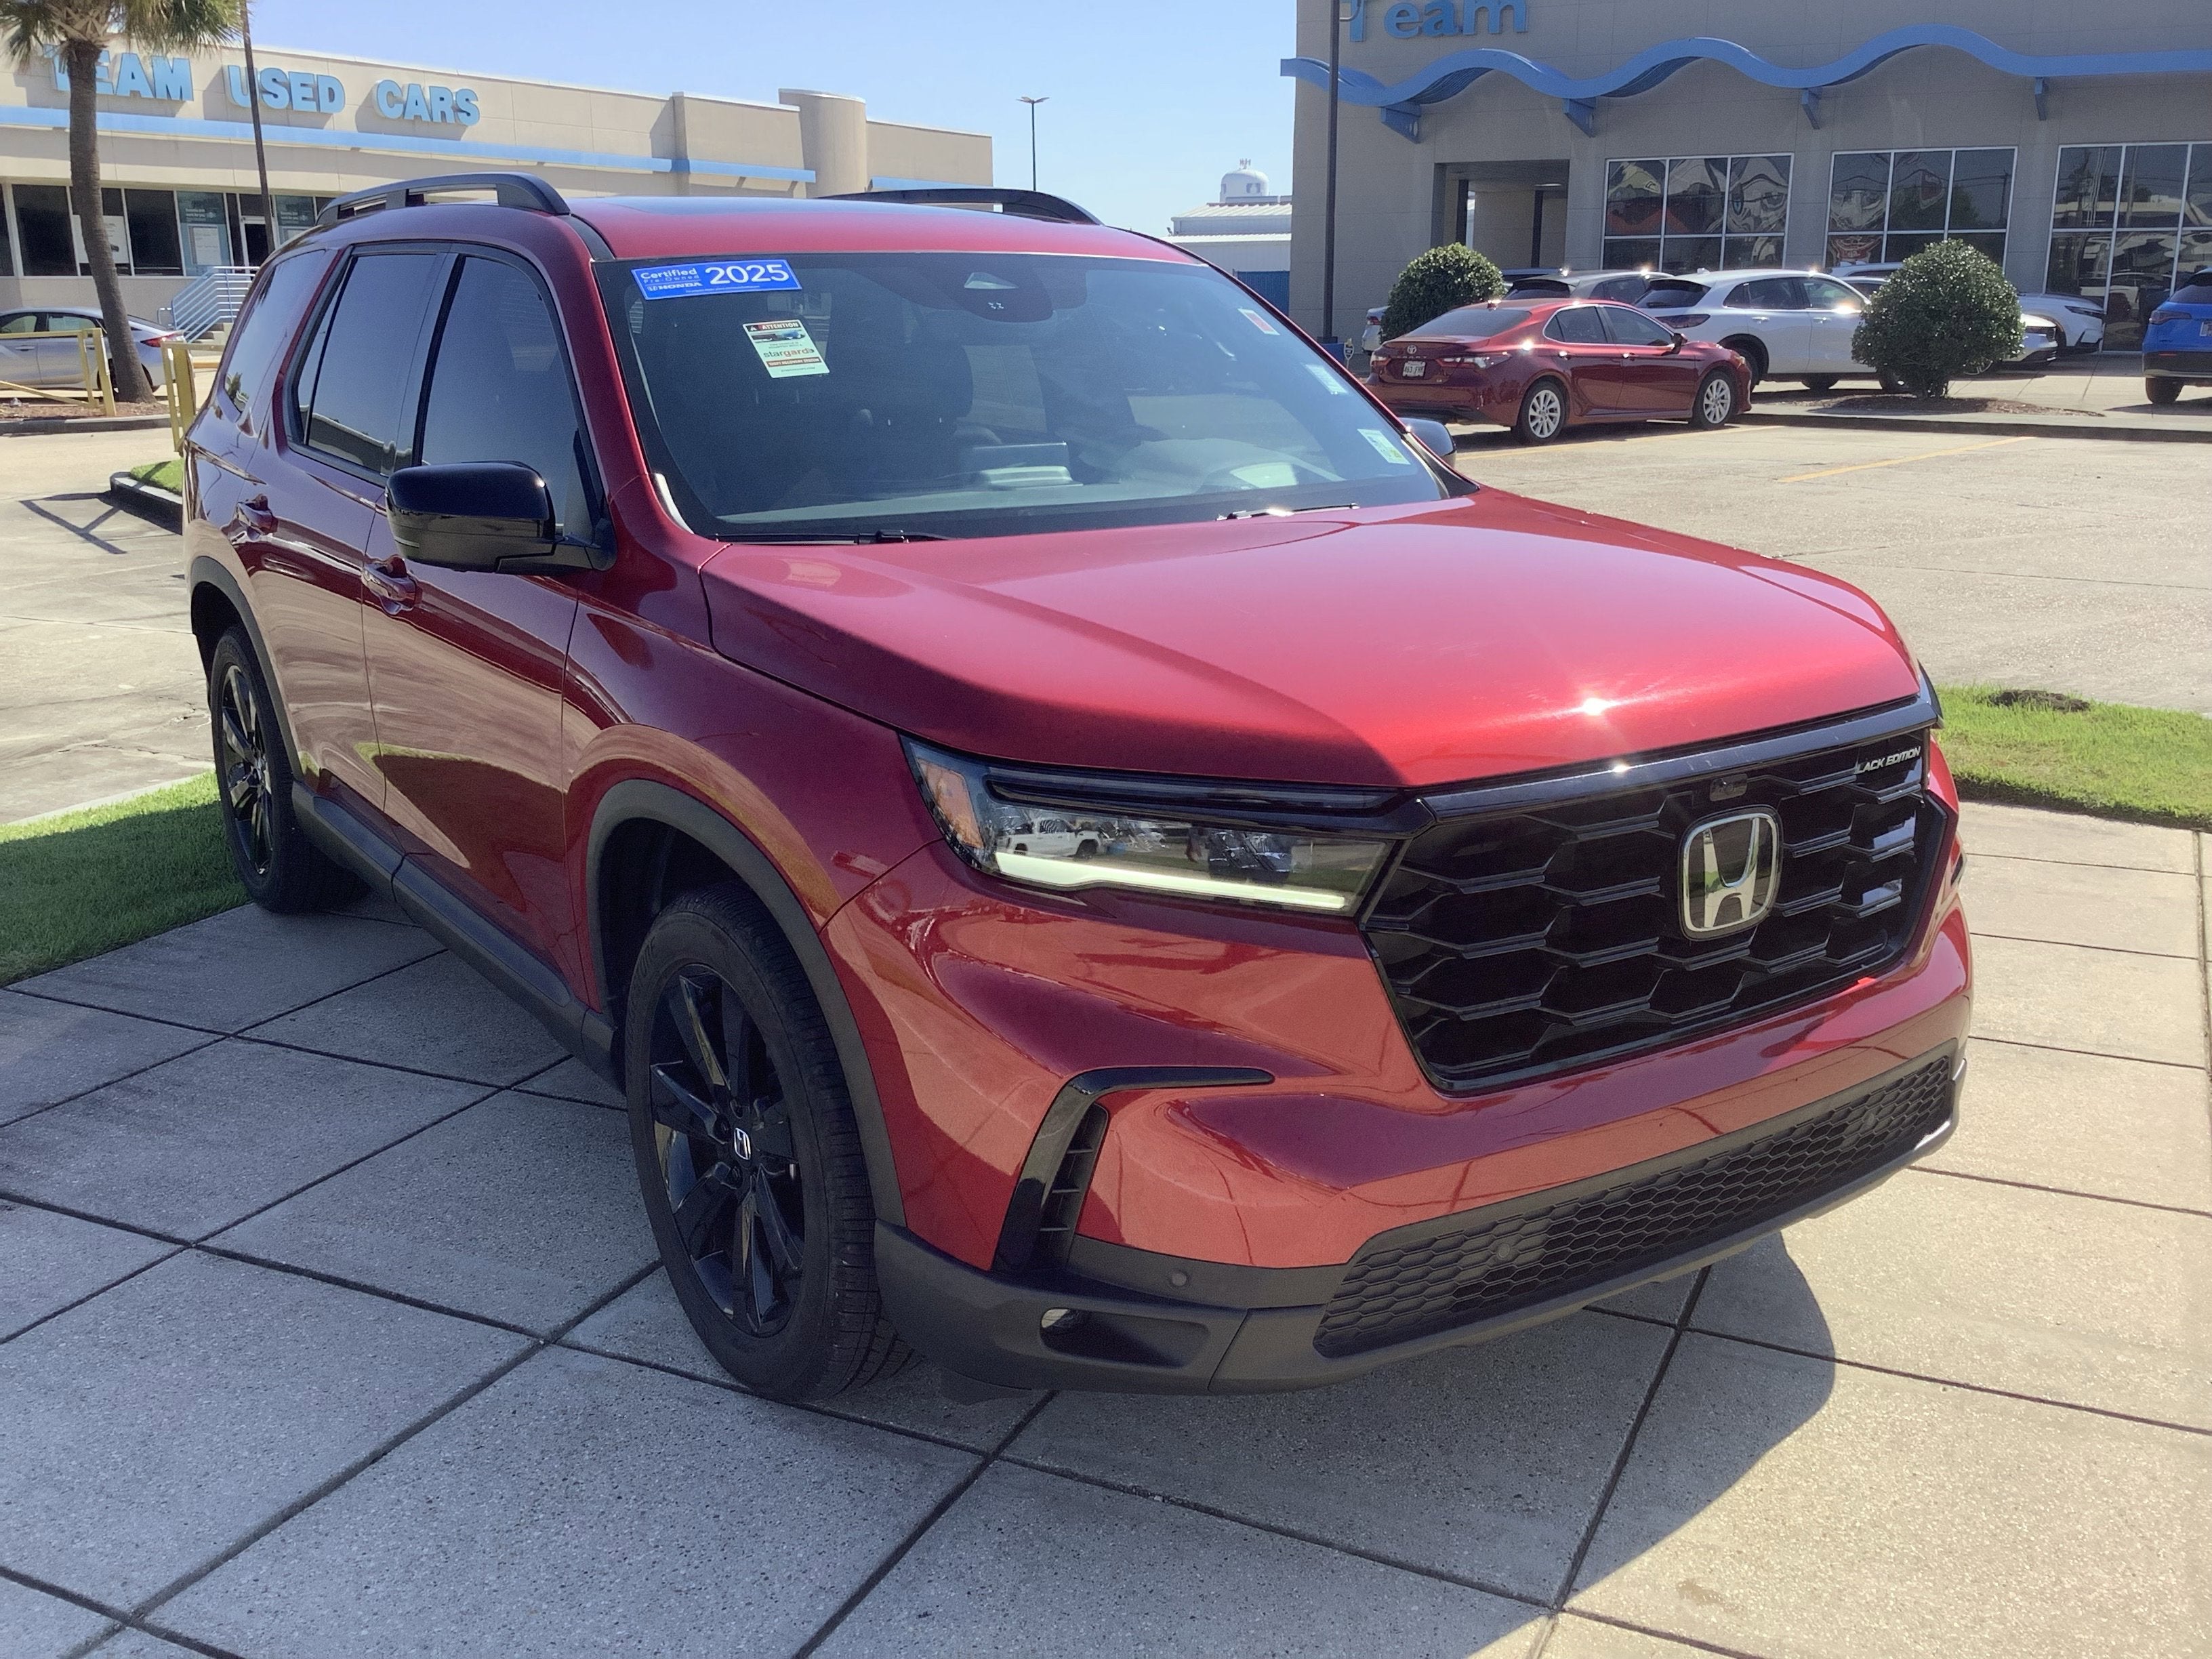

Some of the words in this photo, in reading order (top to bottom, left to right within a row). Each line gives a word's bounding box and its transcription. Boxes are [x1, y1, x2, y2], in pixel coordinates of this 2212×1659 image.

[228, 65, 346, 114] USED
[376, 79, 480, 126] CARS
[640, 268, 697, 279] Certified
[705, 264, 790, 285] 2025
[658, 282, 703, 290] HONDA
[762, 322, 799, 330] ATTENTION
[1885, 746, 1921, 766] EDITION
